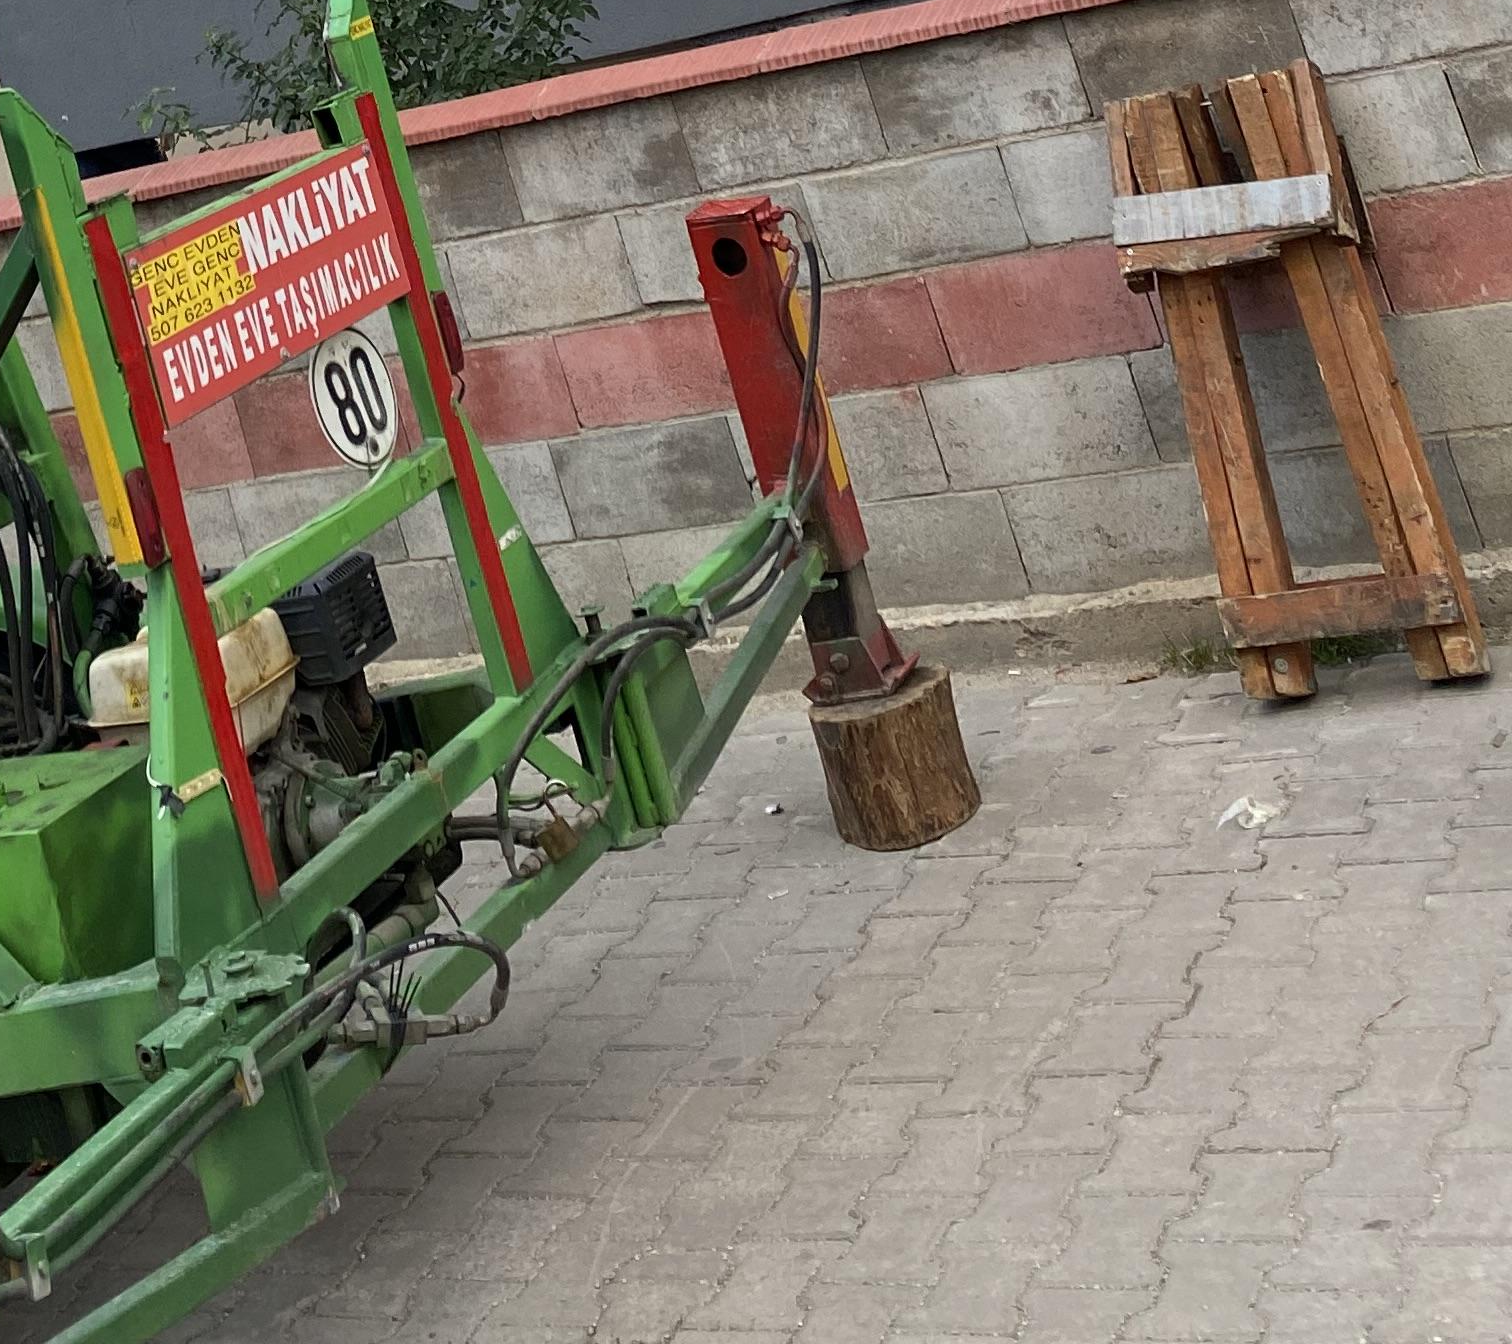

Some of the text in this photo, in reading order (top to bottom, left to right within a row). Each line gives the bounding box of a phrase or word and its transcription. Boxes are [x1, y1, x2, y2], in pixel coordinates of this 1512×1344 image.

[130, 222, 241, 287] GENC EVDEN
[154, 243, 240, 298] EVE GENC
[151, 266, 233, 318] NAKLIYAT
[151, 275, 254, 342] 507 623 1132
[162, 232, 401, 403] EVDEN EVE TAŞIMACILIK
[324, 346, 388, 445] 80
